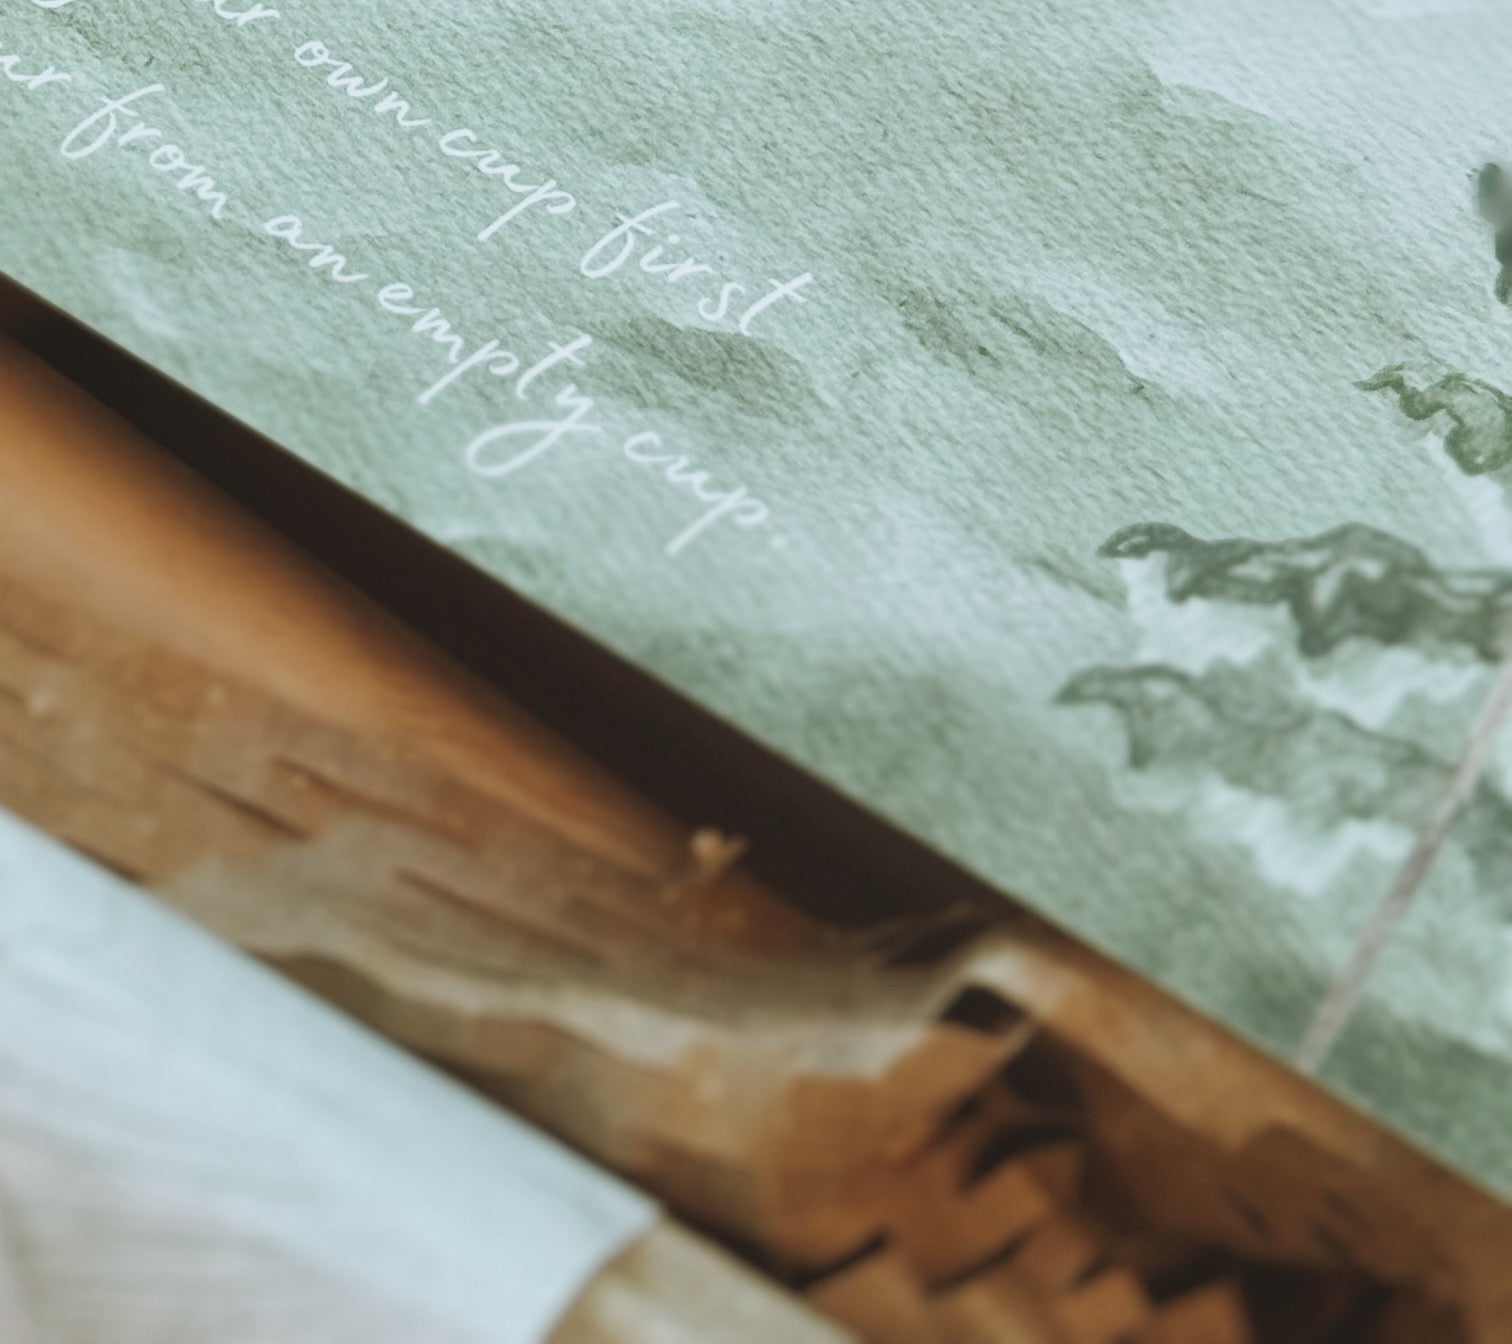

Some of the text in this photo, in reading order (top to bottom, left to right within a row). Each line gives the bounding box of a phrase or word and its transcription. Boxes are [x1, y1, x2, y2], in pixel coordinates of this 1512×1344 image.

[60, 83, 227, 220] from
[263, 214, 369, 283] an
[377, 282, 602, 478] empty
[623, 430, 787, 555] cup.
[293, 39, 432, 128] own
[438, 128, 577, 242] cup
[579, 200, 814, 337] first
